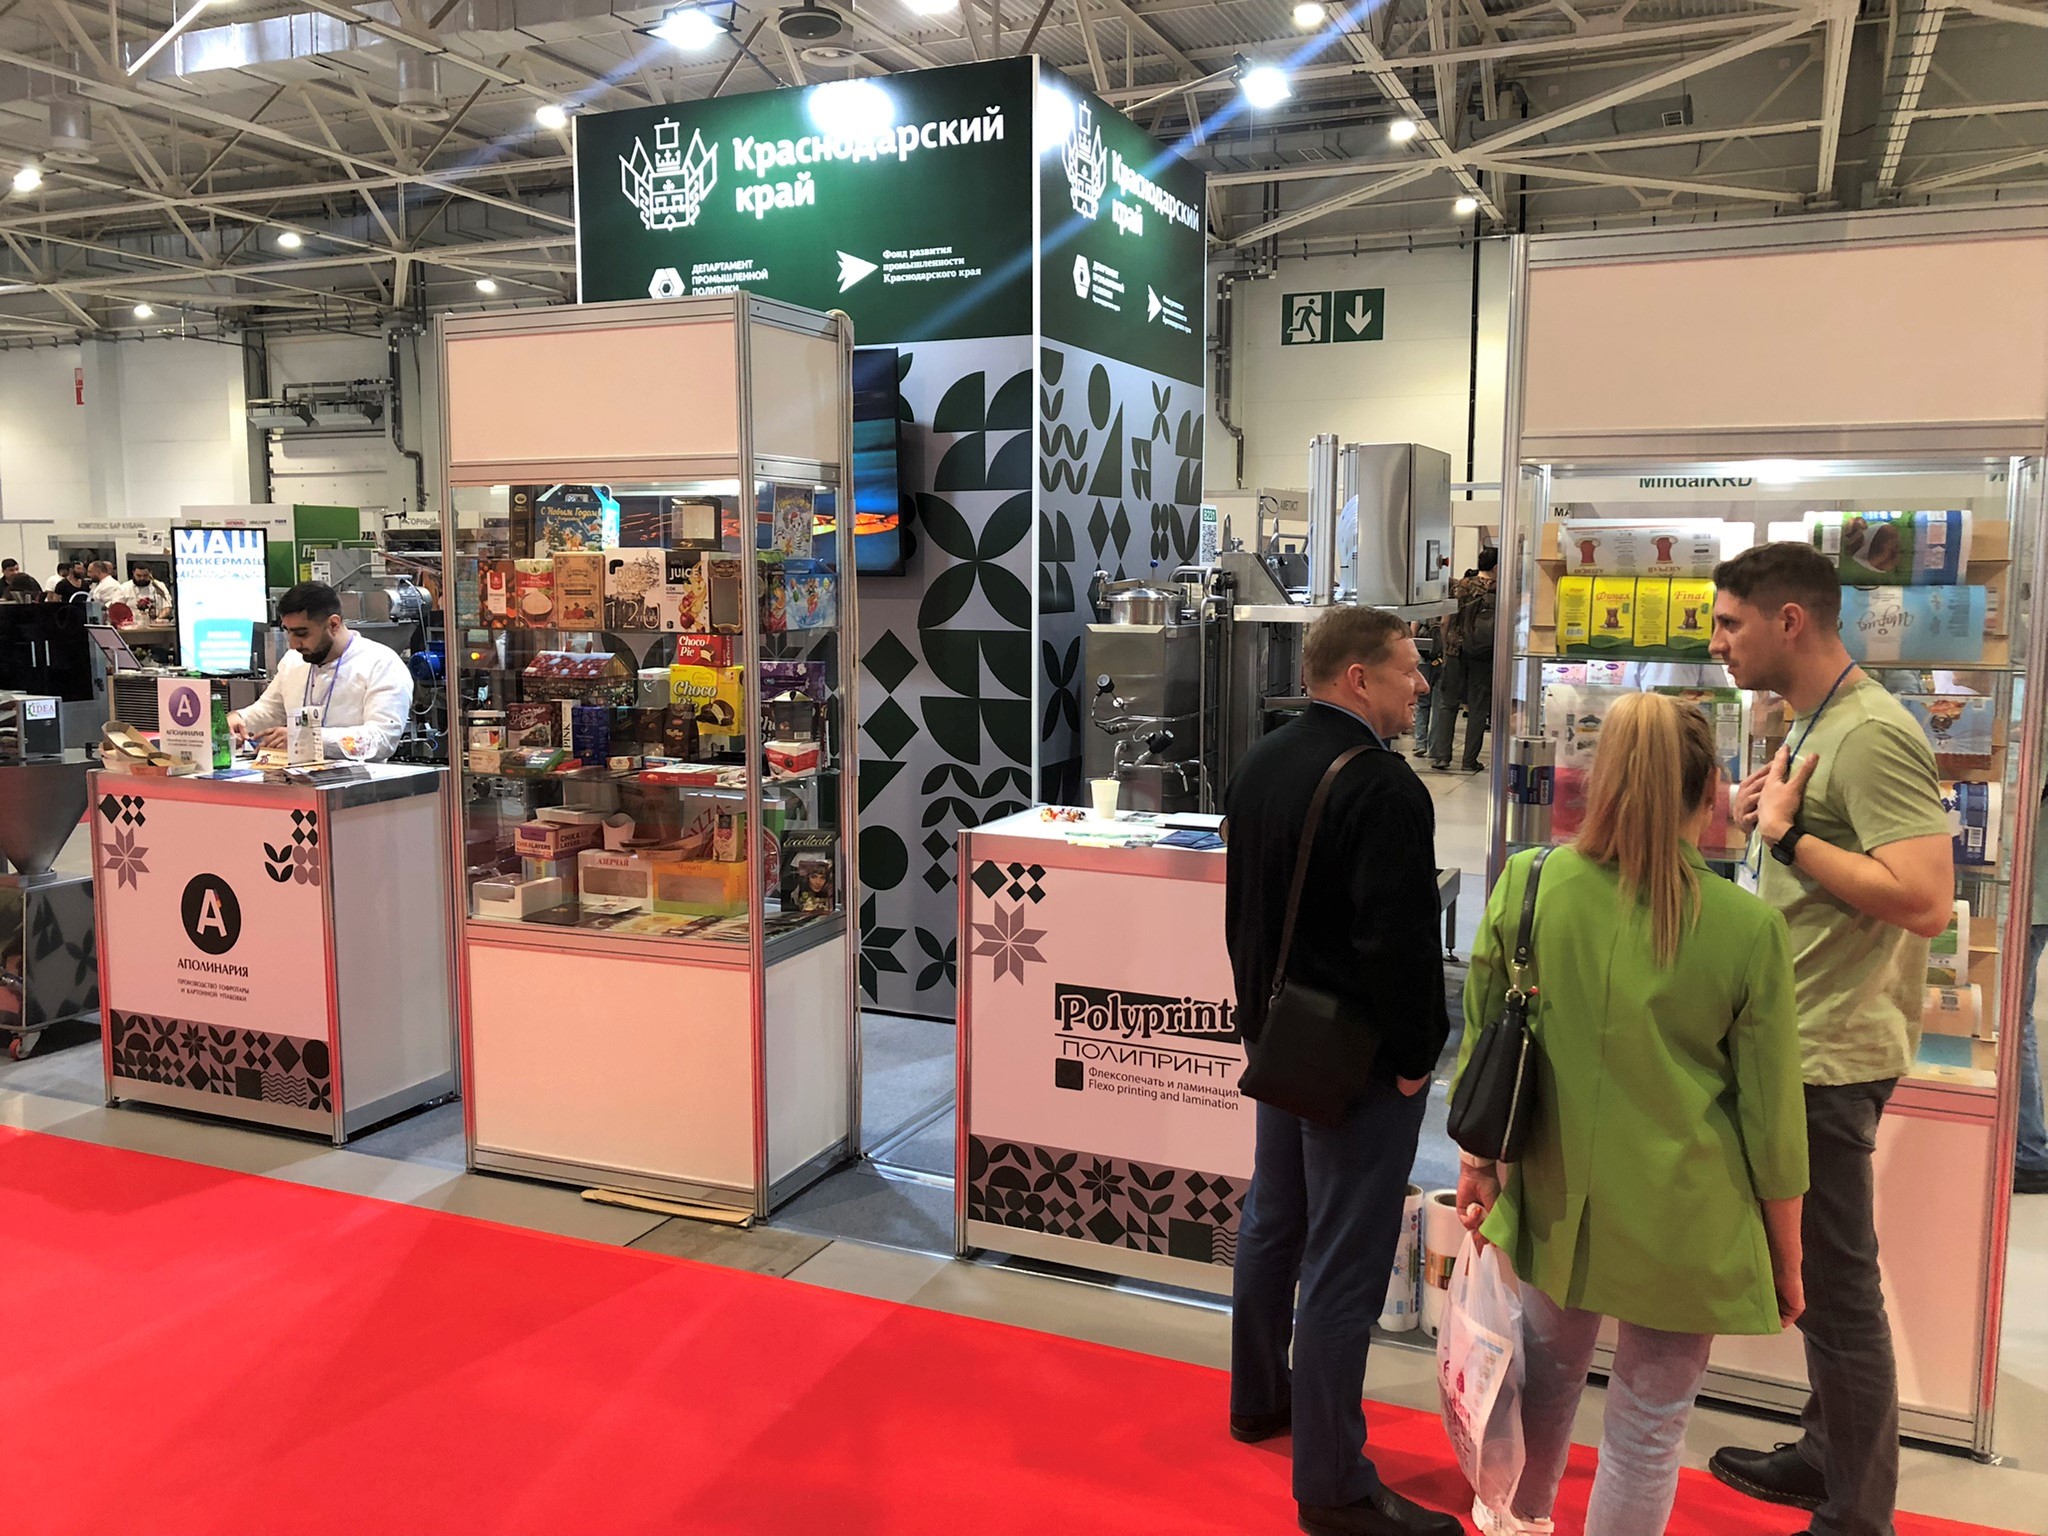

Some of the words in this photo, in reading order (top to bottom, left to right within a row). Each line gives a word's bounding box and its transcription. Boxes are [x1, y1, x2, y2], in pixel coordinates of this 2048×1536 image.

[732, 105, 1005, 178] Краснодарский
[735, 171, 815, 219] край
[1111, 150, 1200, 232] Краснодарский
[1111, 198, 1143, 237] край
[882, 249, 908, 260] Фонд
[909, 246, 952, 258] развития
[691, 259, 753, 275] ДЕПАРТАМЕНТ
[883, 256, 965, 271] промышленности
[691, 269, 769, 286] ПРОМЫШЛЕННОЙ
[883, 270, 956, 284] Краснодарского
[958, 267, 981, 279] края
[692, 284, 739, 296] ПОЛИТИКИ
[547, 507, 573, 516] Новым
[176, 557, 264, 566] ПАККЕРМАШ
[669, 567, 699, 580] JUICE
[1596, 591, 1631, 601] Финал
[1674, 590, 1706, 600] Final
[679, 636, 706, 646] Choco
[680, 646, 695, 657] Pie
[674, 681, 718, 697] Choco
[563, 724, 571, 748] PINK
[560, 832, 580, 842] CHIKA
[598, 858, 629, 867] АЗЕРЧАЙ
[177, 958, 248, 977] АПОЛИНАРИЯ
[177, 978, 217, 989] ПРОИЗВОДСТВО
[219, 984, 249, 994] ГОФРОТАРЫ
[187, 988, 218, 998] КАРТОННОЙ
[219, 993, 247, 1002] УПАКОВКИ
[1060, 992, 1235, 1039] Polyprint
[1063, 1040, 1231, 1078] ПОЛИПРИНТ
[1088, 1066, 1164, 1088] Флексопечать
[1167, 1081, 1174, 1089] и
[1177, 1081, 1239, 1098] ламинация
[1089, 1079, 1115, 1092] Flexo
[1117, 1083, 1157, 1101] printing
[1160, 1088, 1180, 1102] and
[1182, 1090, 1239, 1111] lamination
